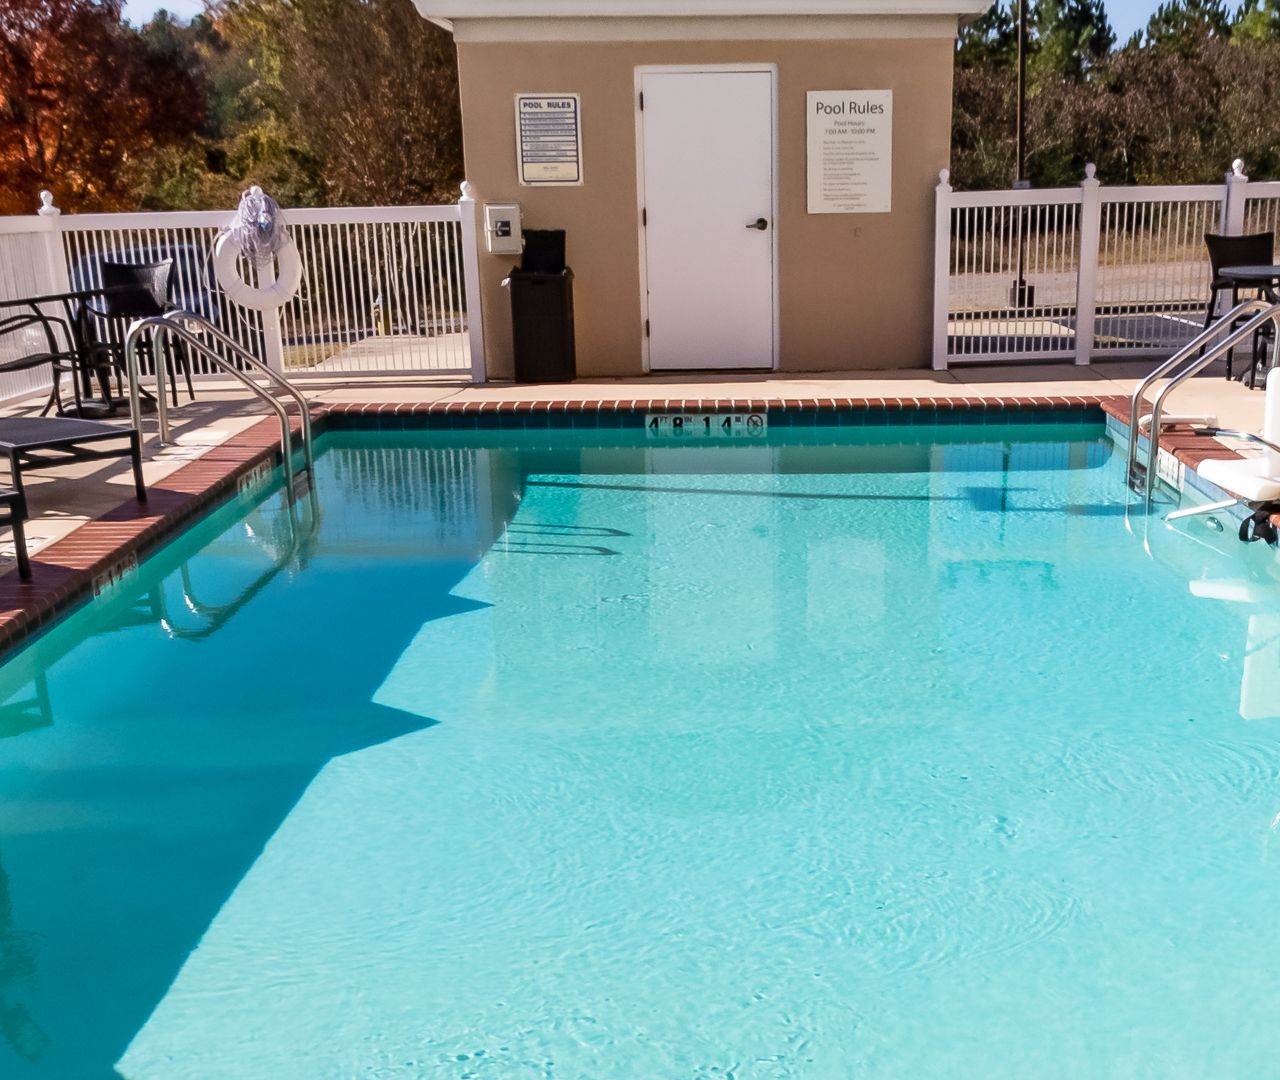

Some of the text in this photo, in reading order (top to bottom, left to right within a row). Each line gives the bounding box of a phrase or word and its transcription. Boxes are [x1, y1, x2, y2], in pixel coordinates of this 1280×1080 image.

[523, 101, 571, 109] POOL RULES
[816, 101, 884, 115] Pool Rules
